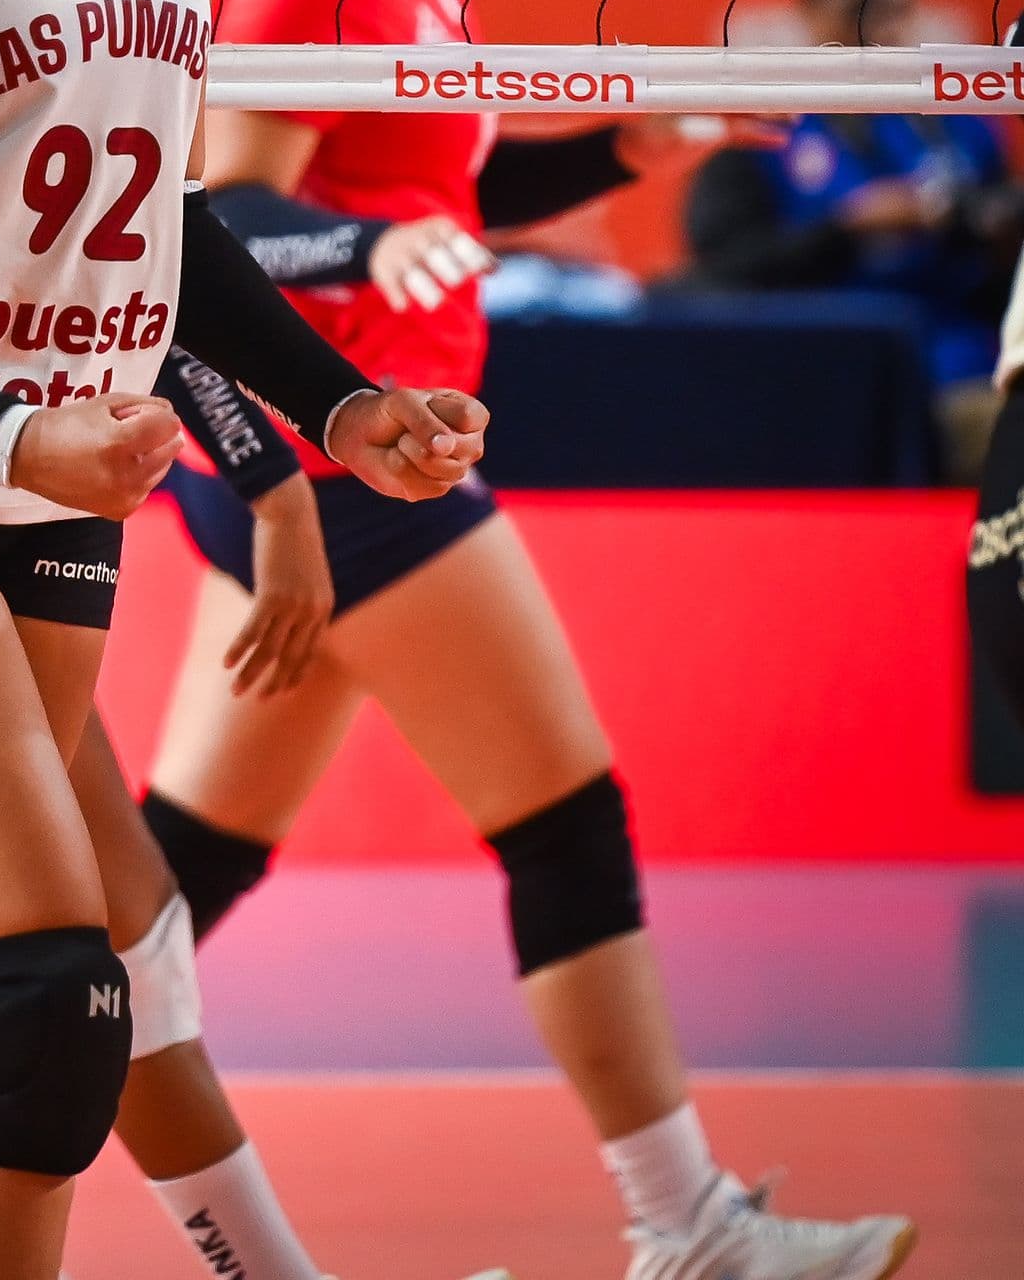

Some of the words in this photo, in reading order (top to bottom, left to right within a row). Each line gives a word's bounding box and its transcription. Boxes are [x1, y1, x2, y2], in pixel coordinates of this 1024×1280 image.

[394, 60, 636, 103] betsson
[22, 124, 162, 262] 92
[34, 559, 120, 585] maratho
